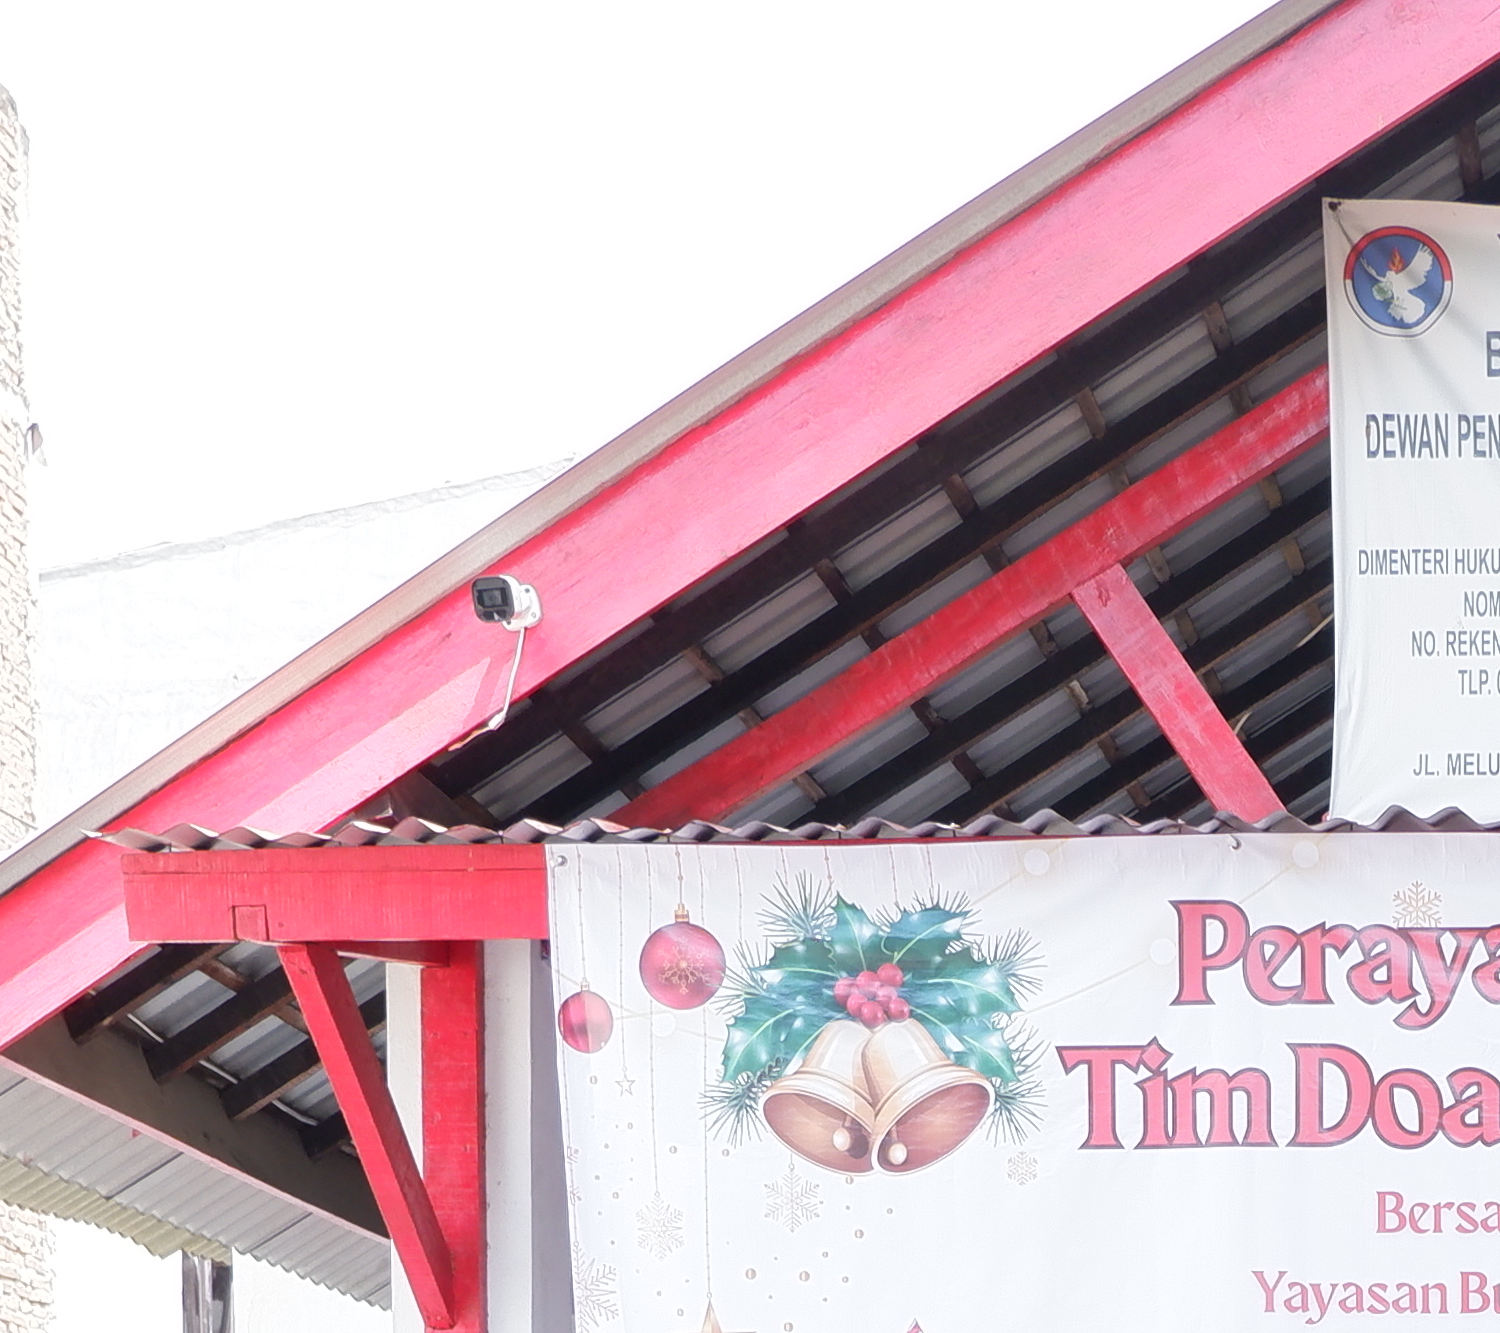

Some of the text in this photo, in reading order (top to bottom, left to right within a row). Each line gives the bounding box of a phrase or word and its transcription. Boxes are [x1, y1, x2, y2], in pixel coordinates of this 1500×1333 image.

[1364, 412, 1449, 459] DEWAN
[1358, 548, 1449, 576] DIMENTERI
[1411, 630, 1440, 657] NO.
[1457, 668, 1492, 696] TLP.
[1412, 753, 1440, 777] JL.
[1055, 1036, 1280, 1151] Tim
[1250, 1270, 1450, 1326] Yayasan
